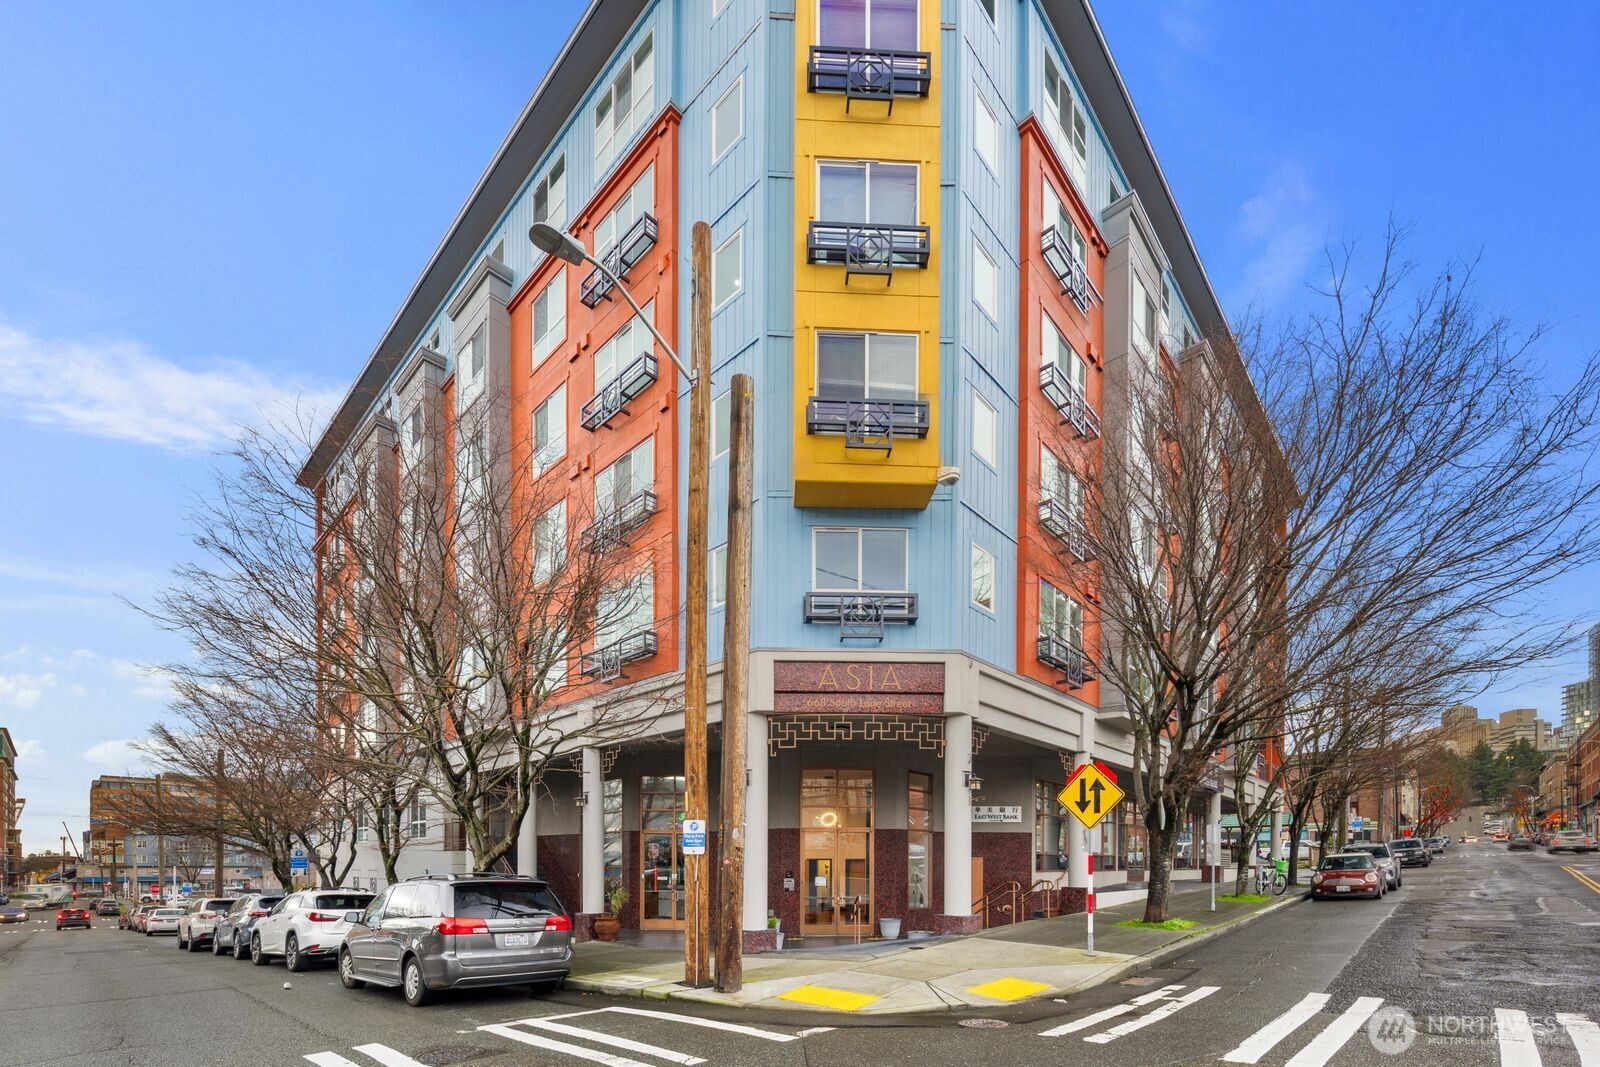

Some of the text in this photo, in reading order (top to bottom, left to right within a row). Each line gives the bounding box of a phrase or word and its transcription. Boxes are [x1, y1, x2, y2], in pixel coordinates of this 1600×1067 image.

[818, 664, 902, 690] ASIA
[807, 697, 912, 708] 668 South Lane Street
